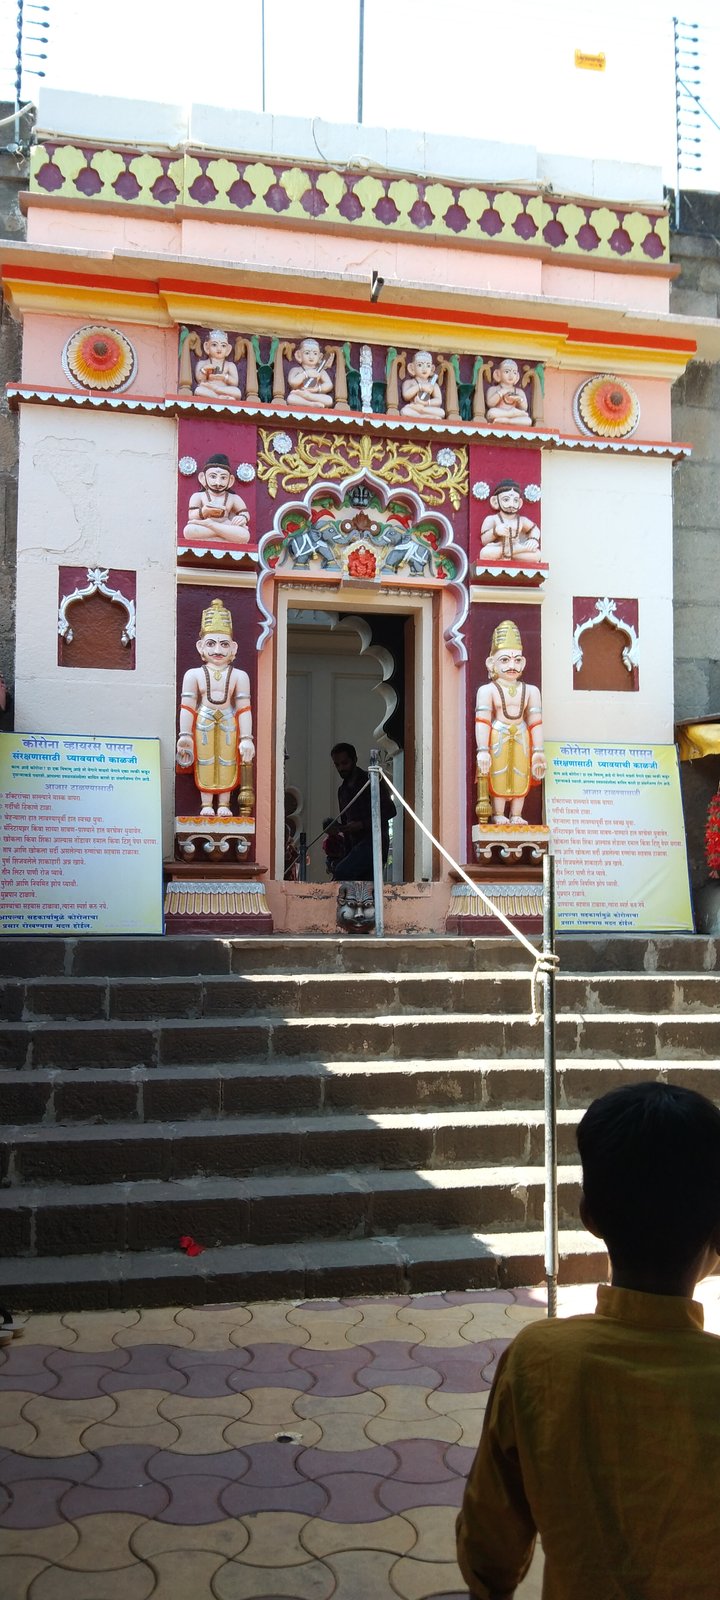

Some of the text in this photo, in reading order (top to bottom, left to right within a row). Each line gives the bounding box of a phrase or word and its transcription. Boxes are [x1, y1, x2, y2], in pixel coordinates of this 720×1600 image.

[22, 736, 59, 750] कोरोना
[63, 741, 101, 752] व्हायरस
[560, 743, 591, 756] कोरोना
[593, 748, 626, 758] व्हायरस
[12, 750, 60, 762] संरक्षणासाठी
[108, 753, 137, 765] काळजी
[553, 757, 593, 768] संरक्षणासाठी
